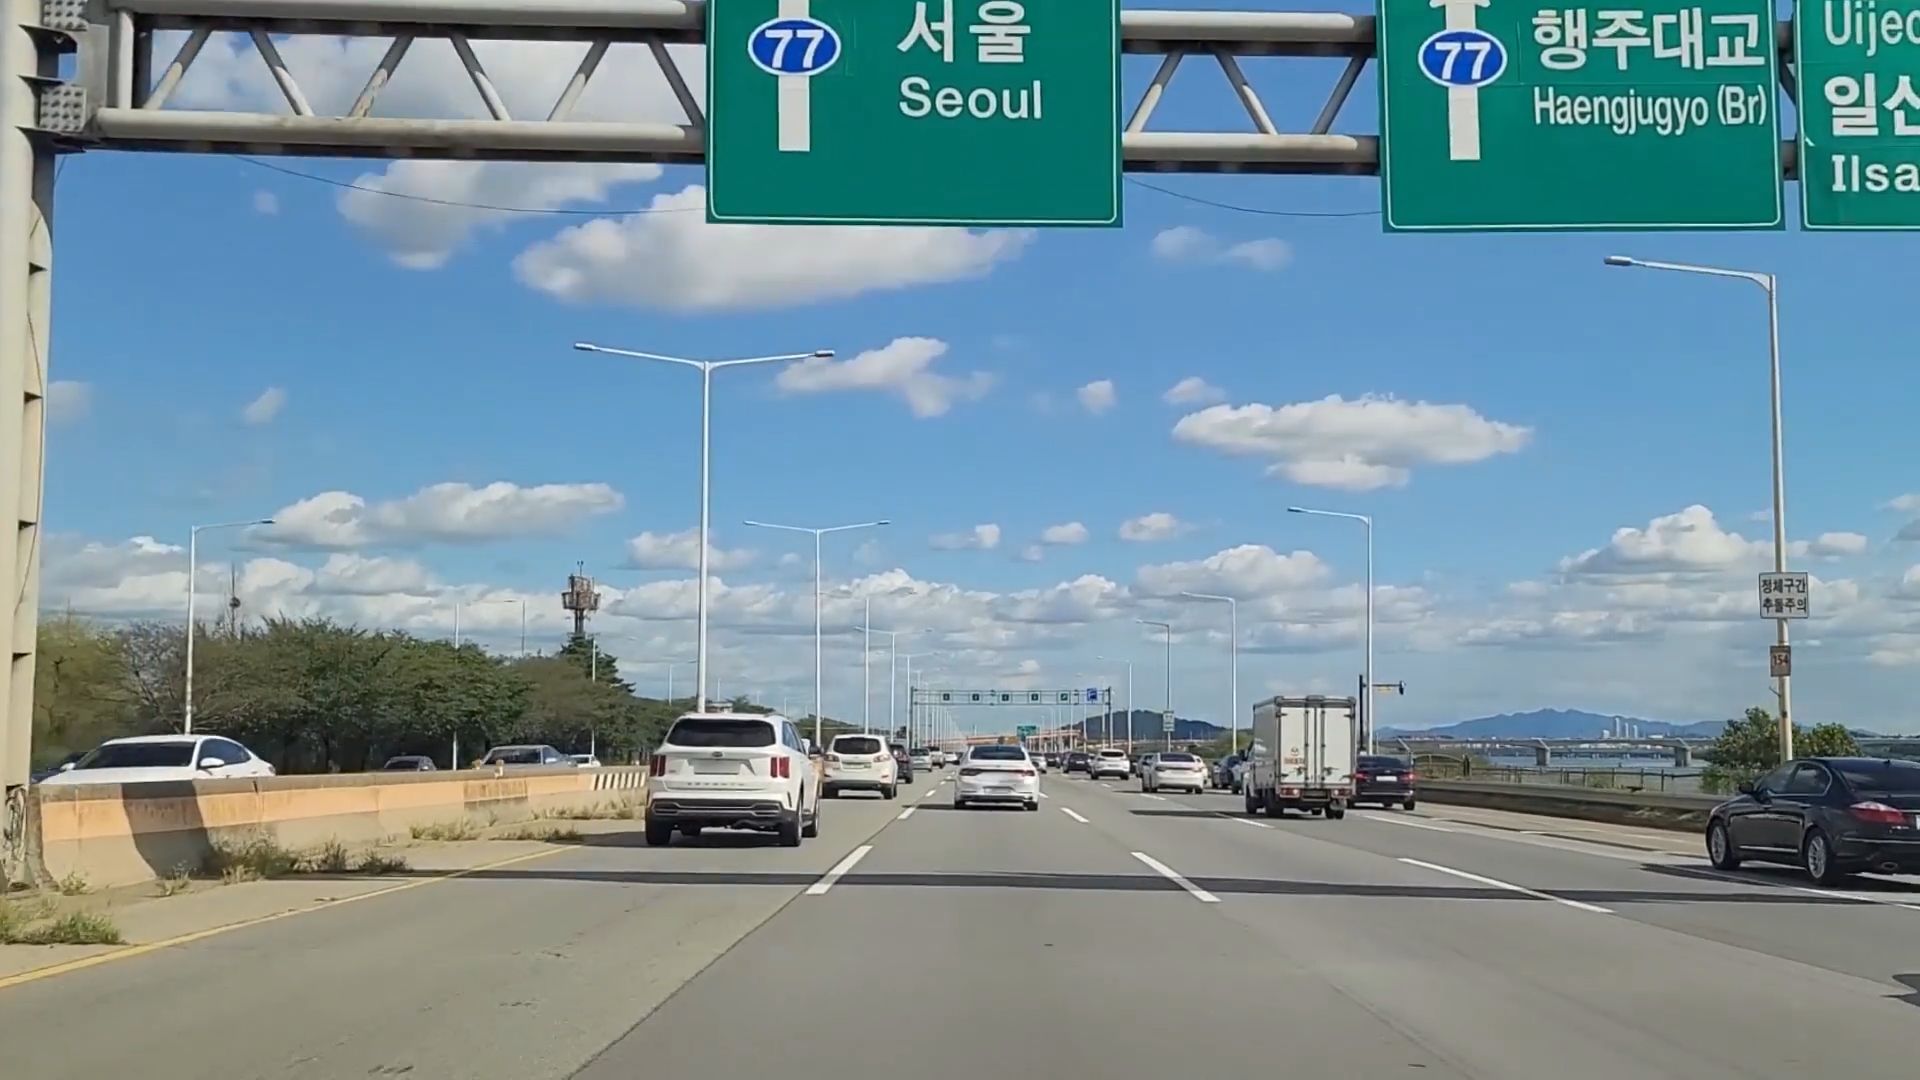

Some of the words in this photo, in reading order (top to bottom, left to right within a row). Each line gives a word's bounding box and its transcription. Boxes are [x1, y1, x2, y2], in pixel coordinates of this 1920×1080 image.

[764, 29, 825, 69] 77
[897, 0, 1031, 63] 서울
[1532, 7, 1765, 70] 행주대교
[1434, 41, 1491, 80] 77
[899, 76, 1042, 119] Seoul
[1534, 86, 1709, 136] Haengjugyo
[1717, 84, 1767, 126] (Br)
